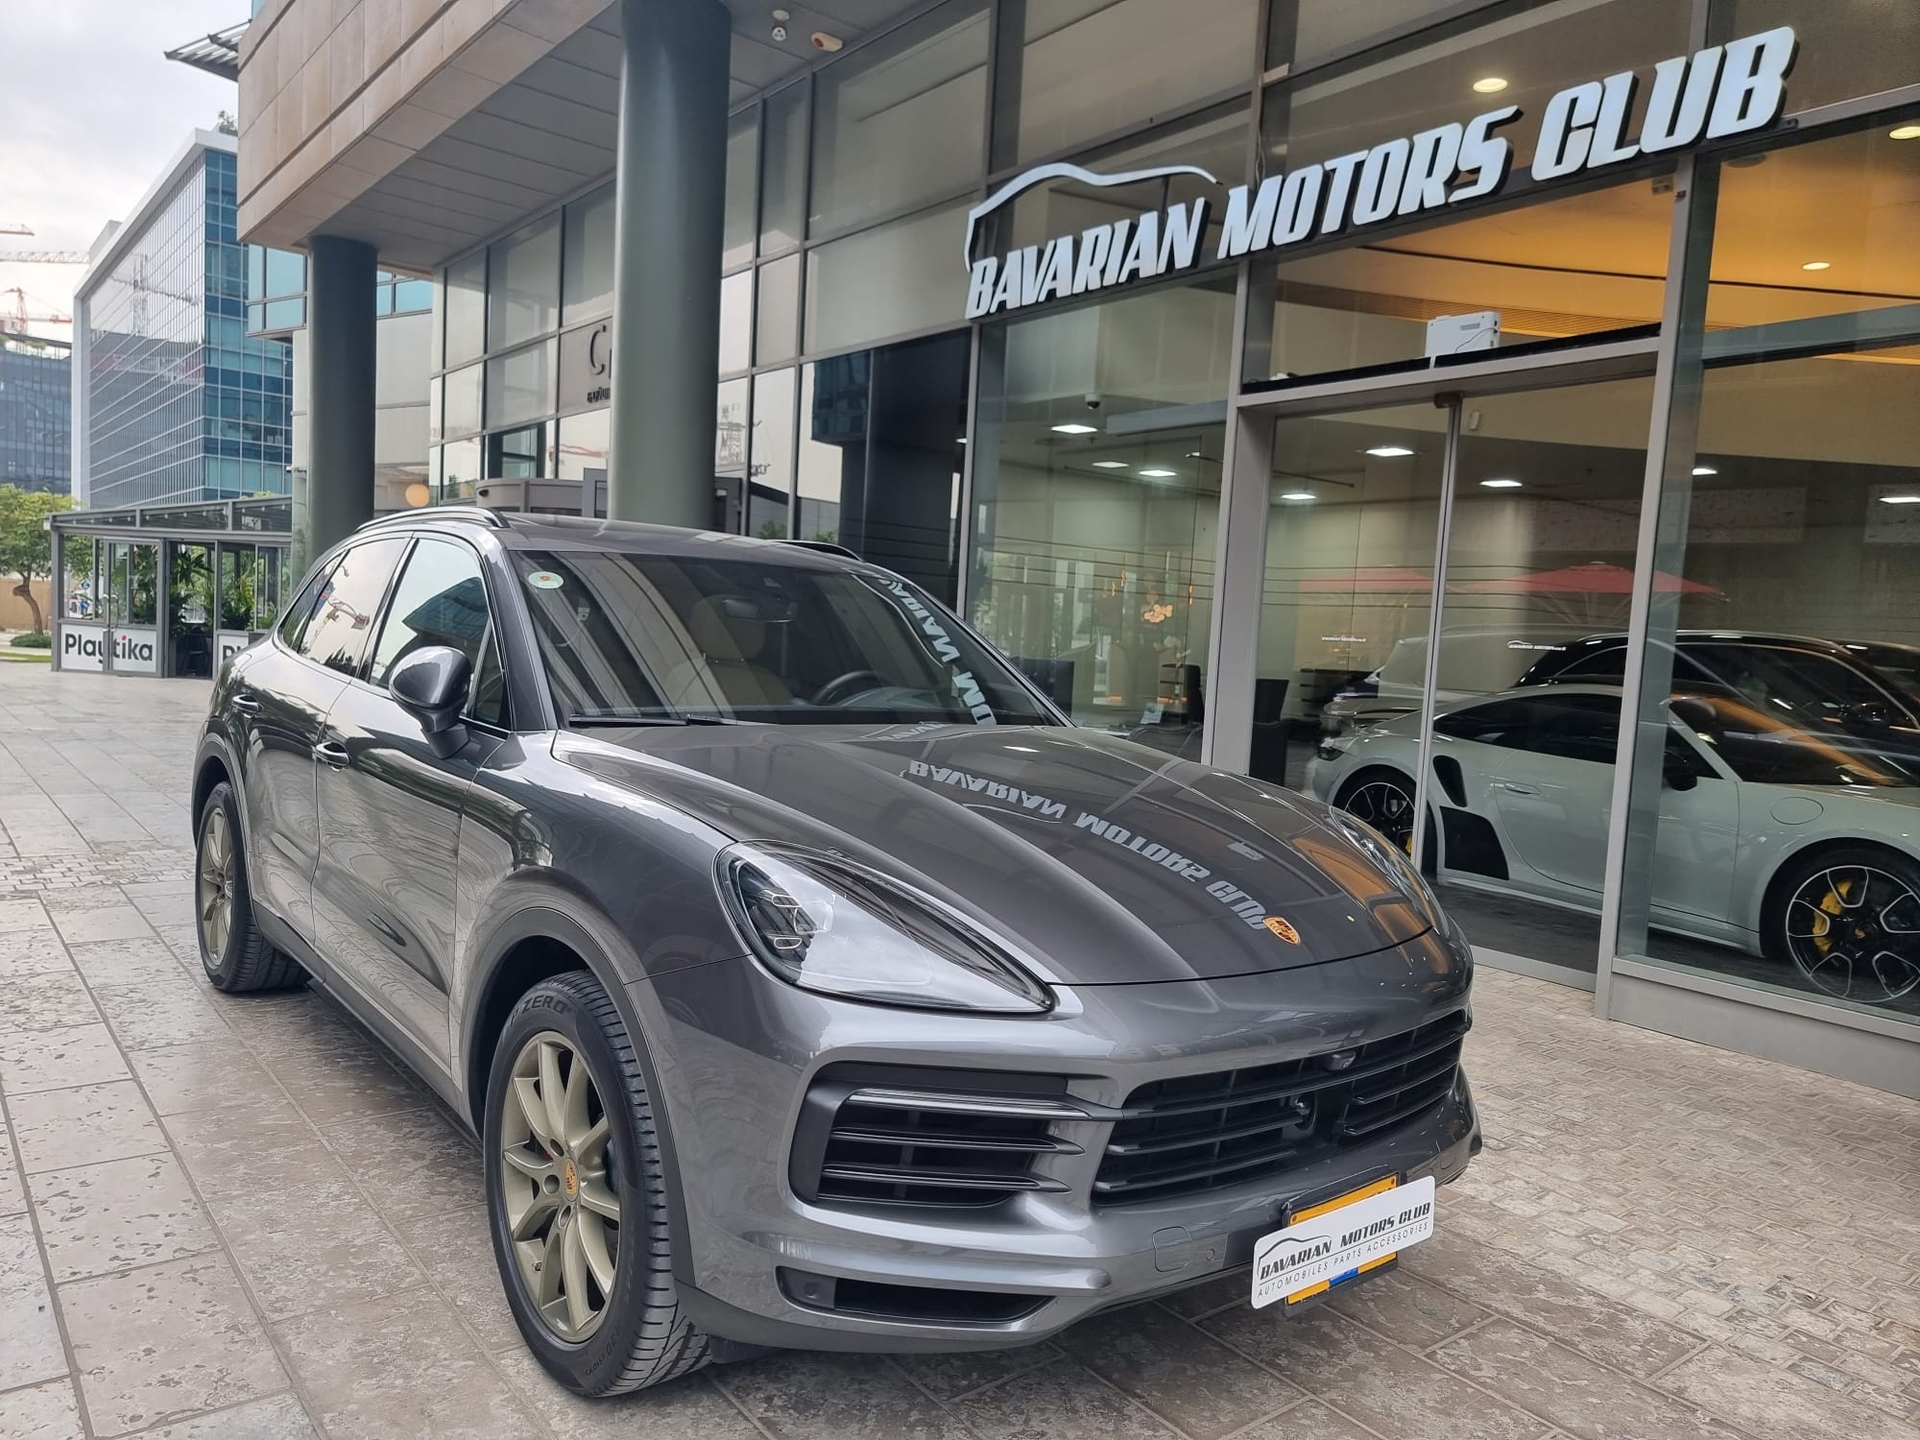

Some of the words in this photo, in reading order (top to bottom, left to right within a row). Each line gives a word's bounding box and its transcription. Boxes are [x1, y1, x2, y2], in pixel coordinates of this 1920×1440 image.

[965, 197, 1206, 320] BAVARIAN
[1216, 104, 1523, 260] MOTORS
[1531, 26, 1799, 183] CLUB
[521, 994, 568, 1015] ZERO
[1257, 1263, 1328, 1298] AUTOMOBILES
[1334, 1250, 1362, 1266] PARTS
[1367, 1221, 1428, 1253] ACCESSORIES
[1259, 1240, 1332, 1280] BAVARIAN
[1340, 1215, 1395, 1248] MOTORS
[1398, 1202, 1431, 1225] CLUB
